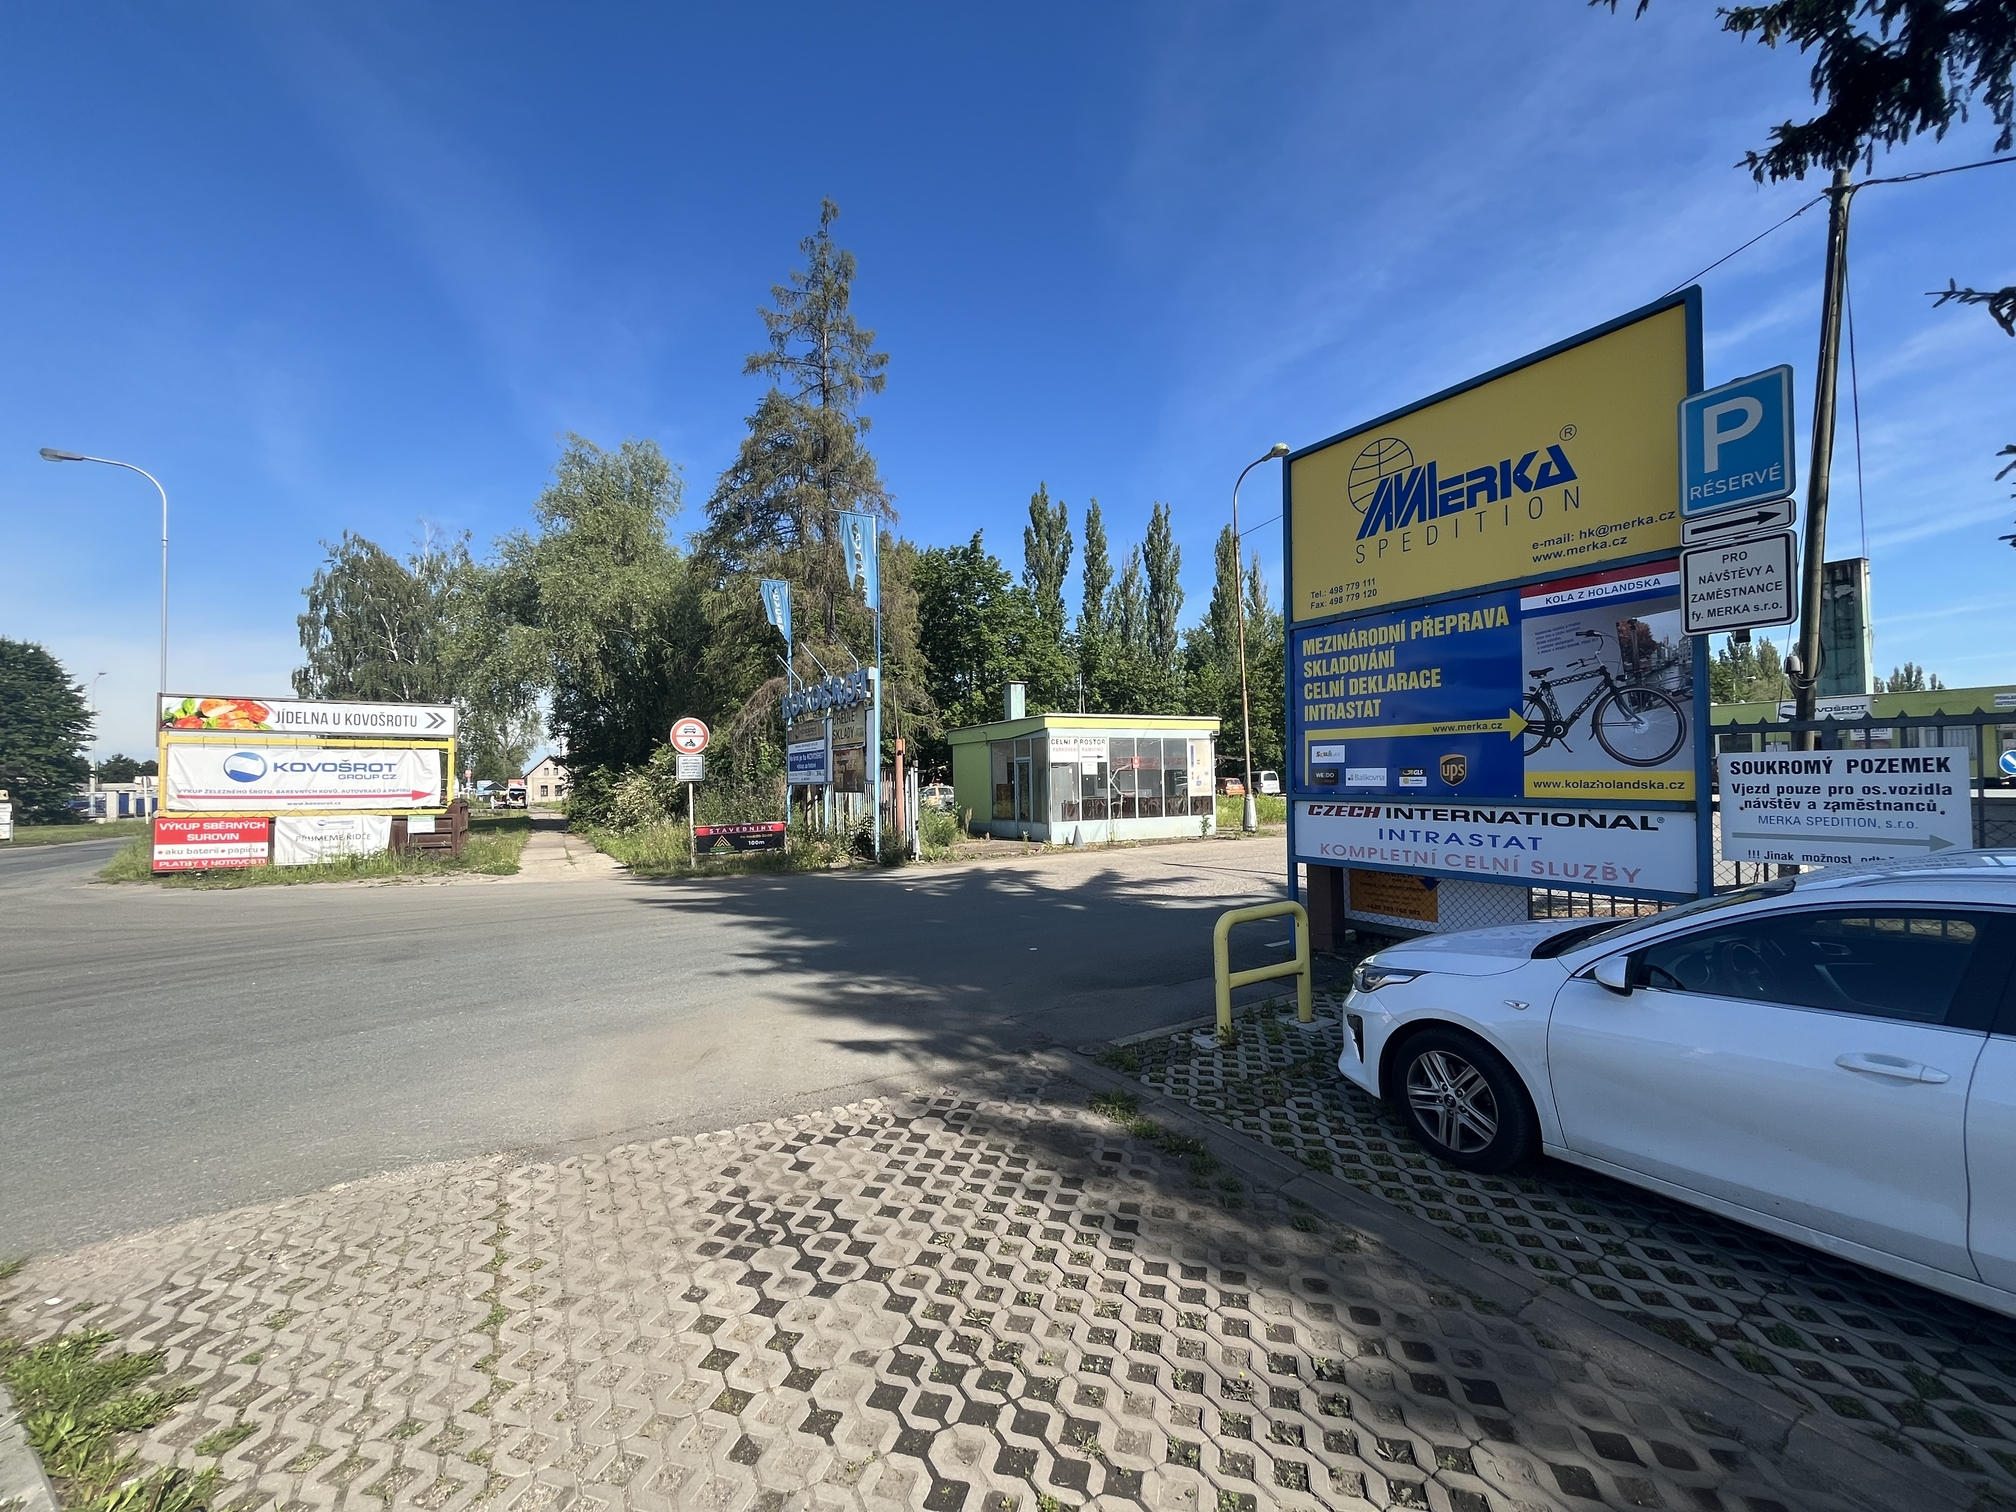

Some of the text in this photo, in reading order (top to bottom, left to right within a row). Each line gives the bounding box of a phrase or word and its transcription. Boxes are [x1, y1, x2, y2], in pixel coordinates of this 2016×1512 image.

[1703, 396, 1763, 474] P
[1690, 461, 1782, 501] RÉSERVÉ
[1355, 444, 1578, 541] MERKA
[1355, 485, 1580, 564] SPEDITION
[1532, 510, 1677, 550] e-mail: hk@merka.cz
[1532, 536, 1628, 563] www.merka.cz
[1722, 551, 1748, 564] PRO
[1698, 564, 1775, 585] NÁVŠTĚVY A
[1310, 578, 1376, 599] Tel.: 498 779 111
[1310, 588, 1377, 610] Fax: 498 779 120
[1545, 578, 1661, 605] KOLA Z HOLANDSKA
[1690, 580, 1783, 604] ZAMĚSTNANCE
[1691, 601, 1783, 622] fy. MERKA s.r.o.
[1302, 619, 1406, 657] MEZINÁRODNÍ
[1410, 605, 1510, 641] PŘEPRAVA
[1303, 646, 1395, 679] SKLADOVÁNÍ
[1303, 668, 1442, 700] CELNÍ DEKLARACE
[275, 708, 418, 728] JÍDELNA U KOVOŠROTU
[1304, 699, 1382, 722] INTRASTAT
[1432, 722, 1503, 733] www.merka.cz
[273, 759, 397, 773] KOVOŠROT
[1442, 764, 1465, 781] ups
[1730, 756, 1951, 775] SOUKROMÝ POZEMEK
[1533, 779, 1685, 790] www.kolazholandska.cz
[1731, 783, 1953, 797] Vjezd pouze pro os.vozidla
[1744, 797, 1937, 812] návštěv a zaměstnanců
[159, 820, 266, 831] VÝKUP SBĚRNÝCH
[1307, 804, 1660, 831] CZECH INTERNATIONAL
[1758, 815, 1919, 829] MERKA SPEDITION, s.r.o.
[187, 833, 240, 841] SUROVIN
[709, 825, 773, 834] STAVEBNINY
[1378, 828, 1543, 851] INTRASTAT
[186, 847, 219, 855] baterií
[1320, 843, 1437, 865] KOMPLETNÍ
[1444, 853, 1521, 873] CELNÍ
[1763, 850, 1795, 862] Jinak
[1801, 852, 1852, 864] možnost
